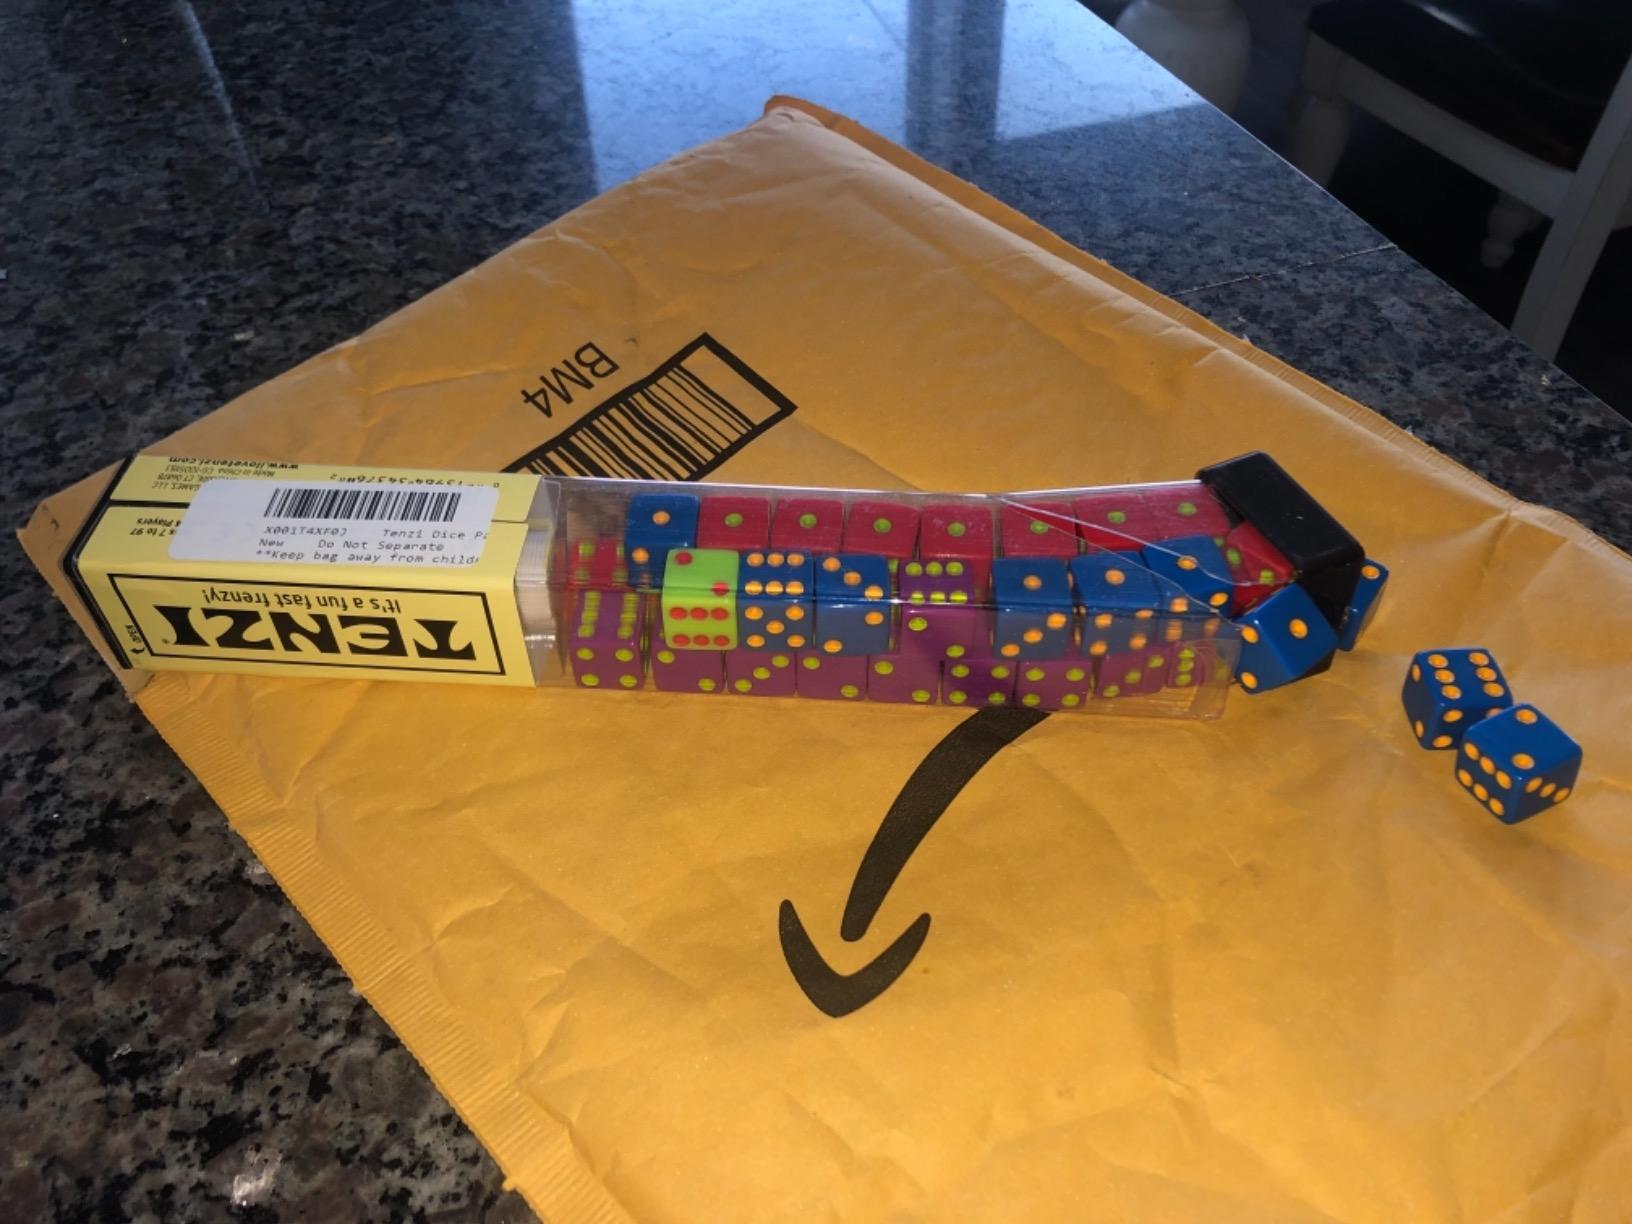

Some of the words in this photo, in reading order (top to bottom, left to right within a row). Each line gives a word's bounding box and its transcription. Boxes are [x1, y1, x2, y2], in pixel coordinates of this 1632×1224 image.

[521, 342, 619, 418] BM4
[168, 456, 298, 469] www.ilovetenzi.com
[137, 518, 175, 528] Players
[130, 528, 143, 536] 97
[144, 528, 157, 536] to
[432, 530, 465, 540] Dice
[258, 539, 285, 547] New
[317, 539, 335, 549] Do
[343, 540, 368, 550] Not
[378, 541, 445, 551] Separate
[313, 551, 338, 563] bag
[347, 553, 380, 564] away
[390, 553, 424, 563] from
[202, 587, 270, 607] frenzy!
[274, 592, 312, 609] fast
[315, 596, 348, 611] fun
[354, 597, 364, 608] a
[369, 598, 401, 614] It's
[153, 605, 476, 661] TENZI
